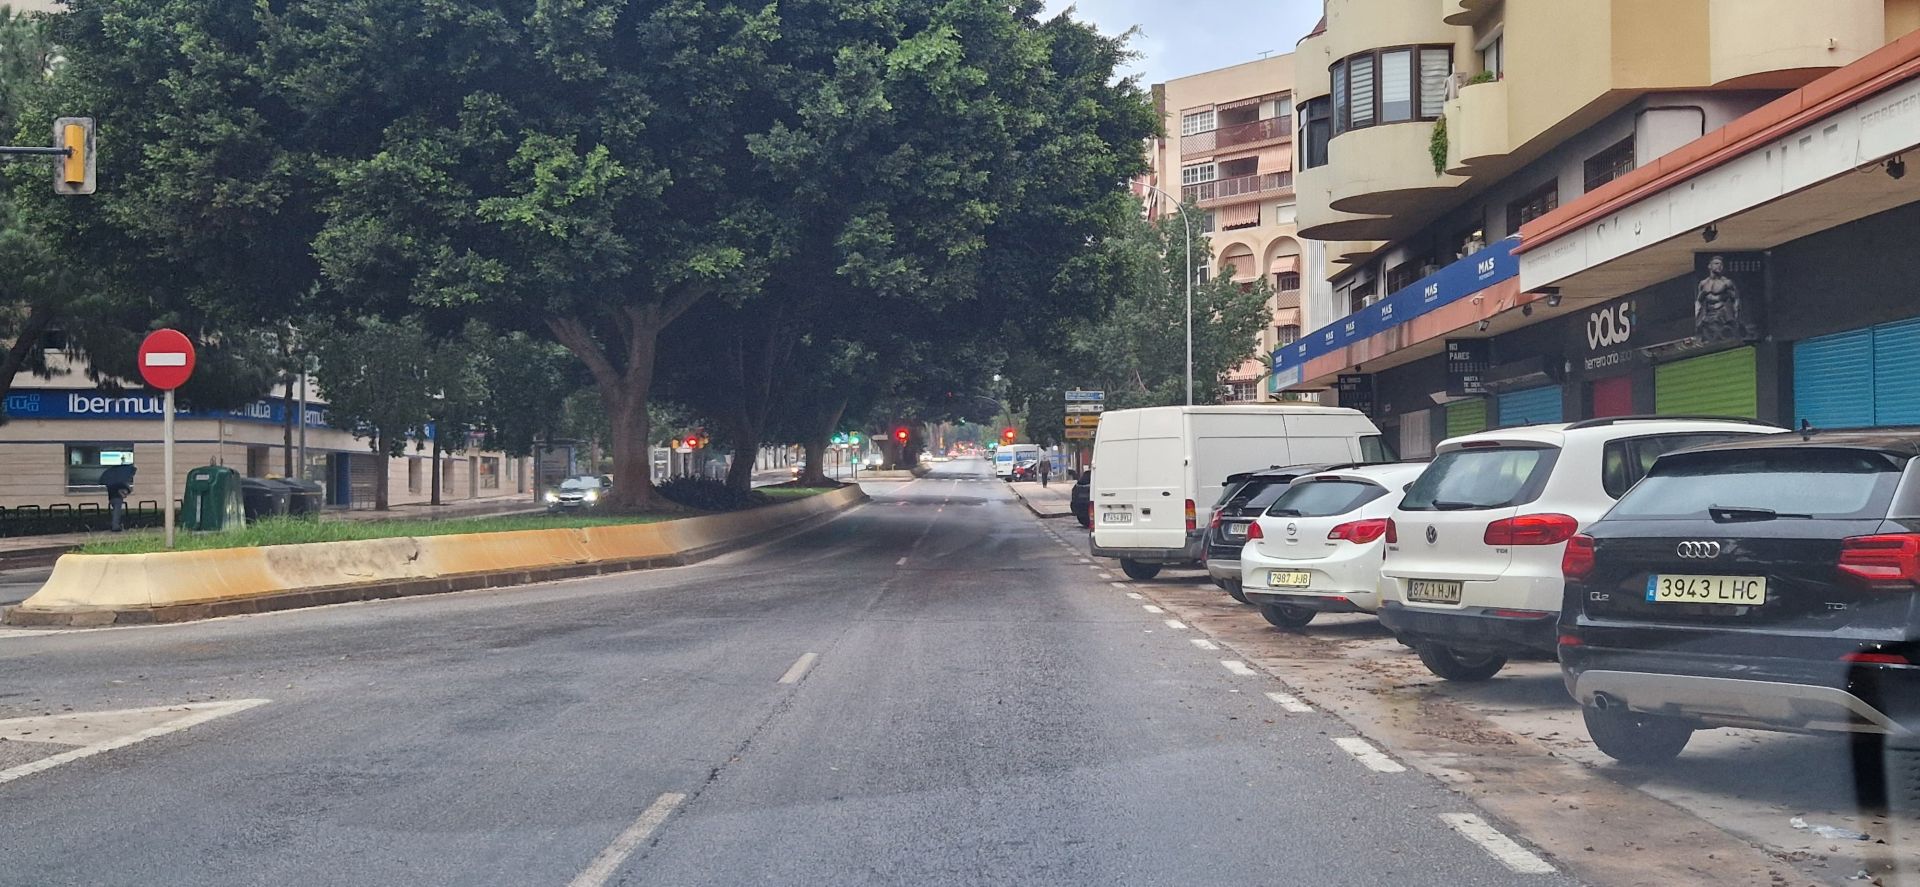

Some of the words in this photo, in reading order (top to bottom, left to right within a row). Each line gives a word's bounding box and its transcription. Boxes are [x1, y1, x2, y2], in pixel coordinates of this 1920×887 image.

[1860, 92, 1920, 125] FERRETER
[1478, 256, 1495, 274] MAS
[1424, 282, 1438, 298] MAS
[1381, 303, 1393, 317] MAS
[1449, 352, 1470, 361] PARES
[1271, 573, 1291, 583] 7987
[1412, 580, 1435, 597] 8741
[1438, 583, 1457, 600] HJM
[1661, 578, 1711, 599] 3943
[1718, 579, 1759, 601] LHC
